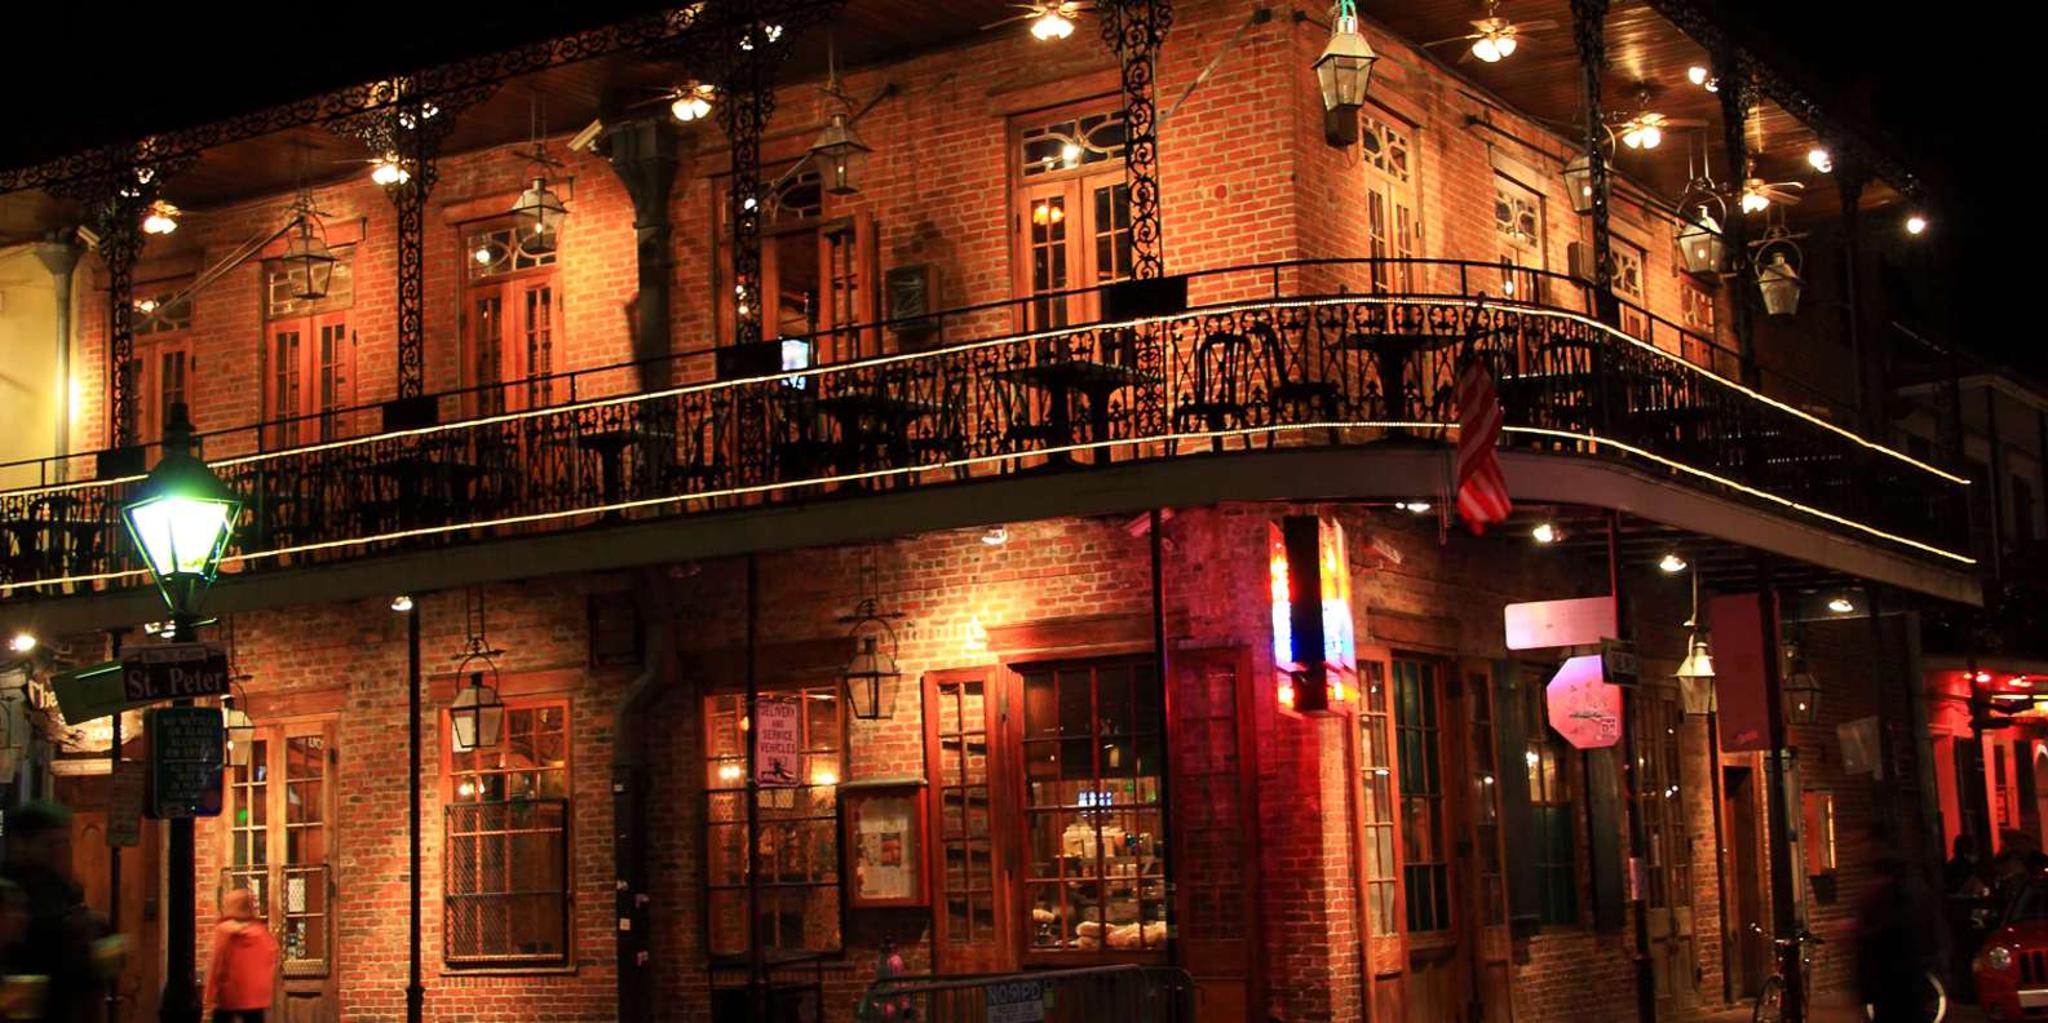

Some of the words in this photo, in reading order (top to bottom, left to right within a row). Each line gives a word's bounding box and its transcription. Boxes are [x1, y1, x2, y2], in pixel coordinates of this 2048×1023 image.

[127, 669, 159, 700] St.
[169, 667, 225, 695] Peter
[760, 704, 795, 717] DELIVERY
[763, 730, 793, 741] SERVICE
[760, 742, 796, 754] VEHICLES
